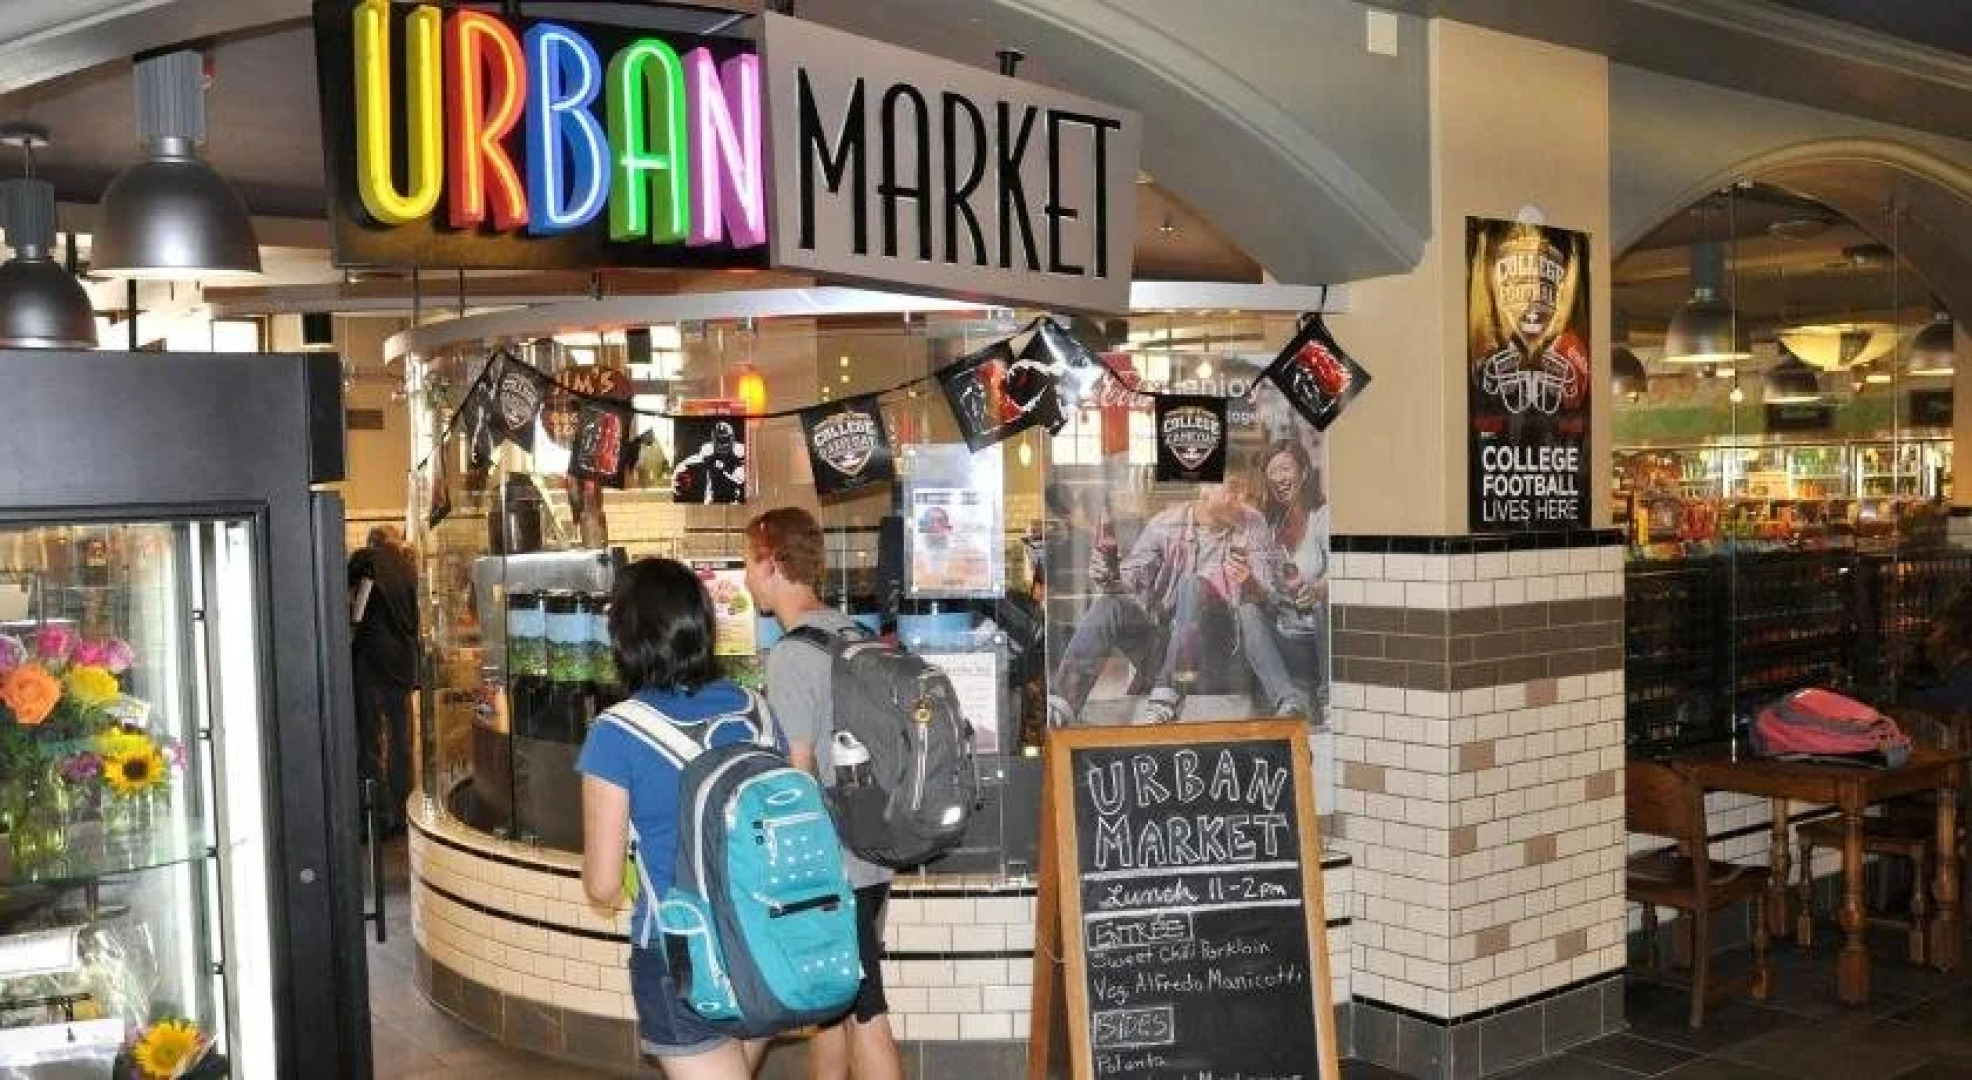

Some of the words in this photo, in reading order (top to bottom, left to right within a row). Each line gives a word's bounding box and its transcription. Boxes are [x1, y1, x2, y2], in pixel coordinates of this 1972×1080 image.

[353, 0, 767, 249] URBAN
[797, 67, 1121, 279] MARKET
[1482, 445, 1579, 472] COLLEGE
[1483, 473, 1579, 496] FOOTBALL
[1483, 499, 1529, 521] LIVES
[1535, 499, 1579, 520] HERE
[1088, 749, 1288, 815] URBAN
[1094, 812, 1288, 868] MARKET
[1107, 877, 1199, 907] Lunch
[1098, 1013, 1168, 1041] SIDES
